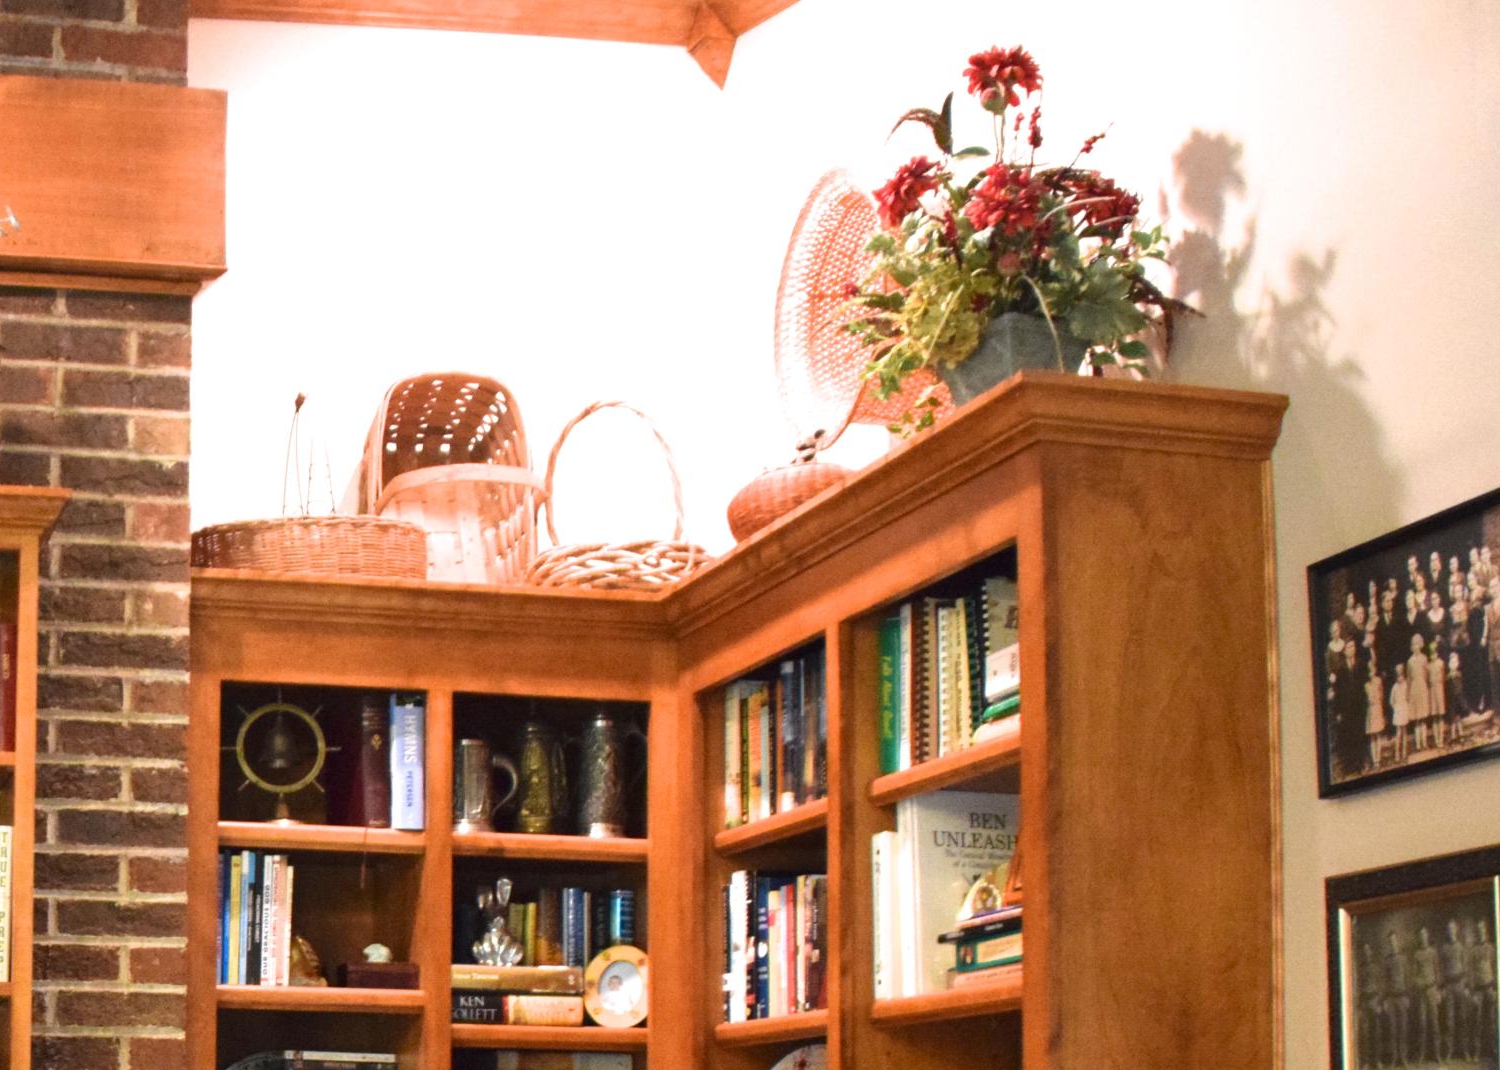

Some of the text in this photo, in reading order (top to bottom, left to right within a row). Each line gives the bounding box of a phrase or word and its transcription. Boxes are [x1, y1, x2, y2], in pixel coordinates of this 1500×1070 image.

[403, 715, 417, 763] HYMNS
[968, 812, 1007, 830] BEN
[0, 831, 8, 888] TRUE
[459, 995, 485, 1007] KEN
[453, 1008, 498, 1021] OLLETT
